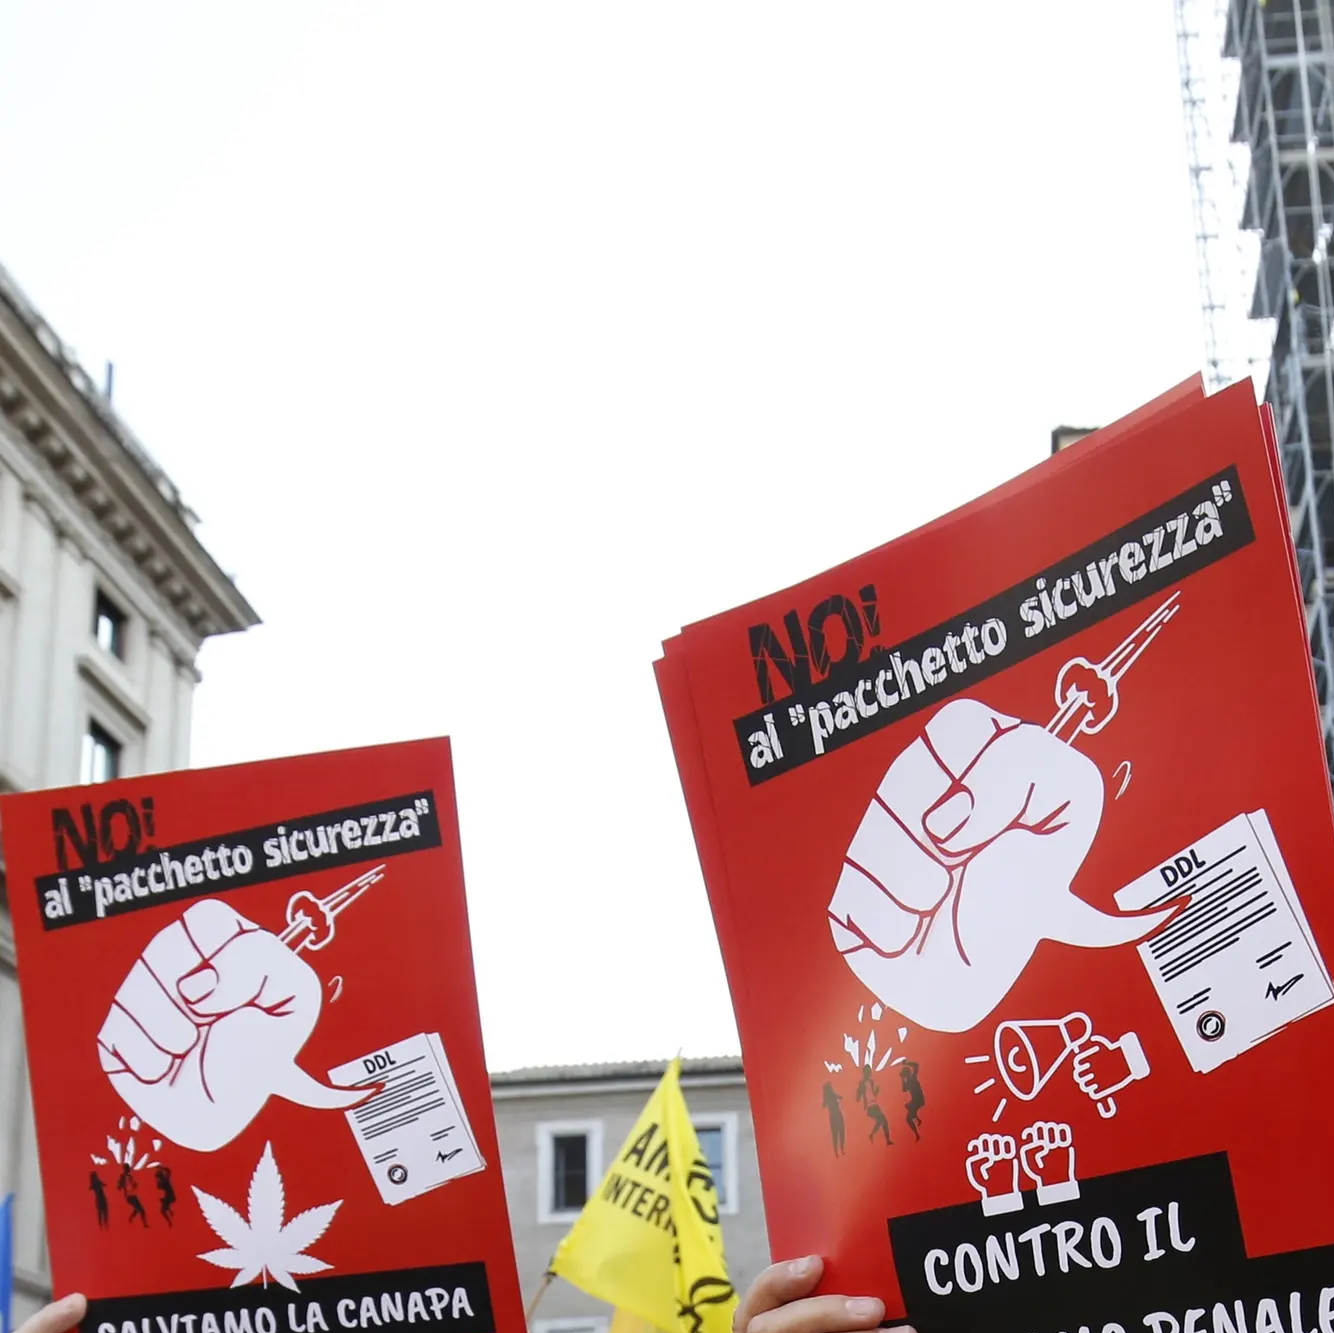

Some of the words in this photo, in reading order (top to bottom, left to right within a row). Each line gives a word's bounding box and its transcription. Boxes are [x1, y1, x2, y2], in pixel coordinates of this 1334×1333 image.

[747, 583, 883, 705] NO!
[748, 720, 783, 768] al
[51, 797, 155, 870] NO!
[1160, 850, 1207, 889] DDL
[44, 877, 73, 919] al
[364, 1051, 397, 1075] DDL
[923, 1216, 1122, 1296] CONTRO
[1136, 1201, 1196, 1262] IL
[287, 1301, 330, 1333] LA
[336, 1287, 475, 1329] CANAPA
